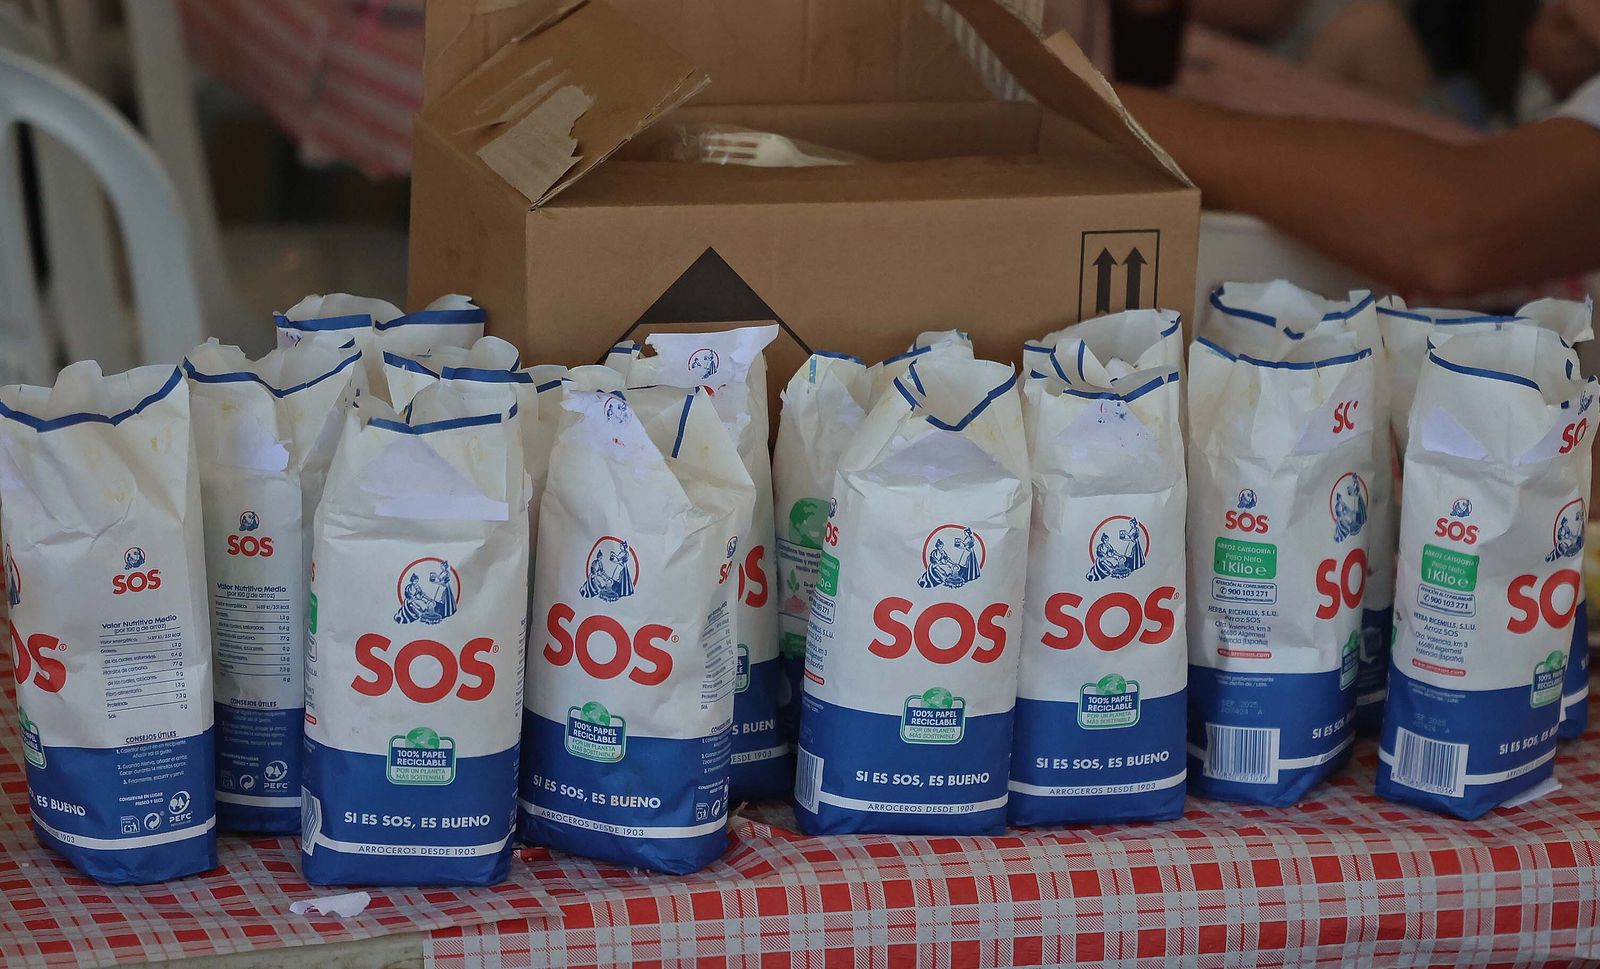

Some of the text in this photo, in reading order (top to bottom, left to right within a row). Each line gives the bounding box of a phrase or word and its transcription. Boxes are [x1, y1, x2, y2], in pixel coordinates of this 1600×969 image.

[1225, 510, 1269, 534] SOS
[1434, 517, 1478, 545] SOS
[227, 535, 274, 557] SOS
[1226, 553, 1242, 561] Peso
[1222, 561, 1254, 574] 1 Kilo
[113, 569, 161, 595] SOS
[1432, 570, 1456, 585] Kilo
[217, 582, 287, 594] Valor Nutritivo Medio
[1430, 596, 1443, 605] 900
[1443, 599, 1455, 607] 103
[1456, 601, 1468, 610] 271
[102, 614, 177, 630] Valor Nutritivo Medio
[1040, 586, 1176, 652] SOS
[868, 596, 1010, 665] SOS
[1424, 624, 1459, 638] Arroz SOS
[543, 603, 674, 687] SOS
[350, 633, 496, 704] SOS
[1087, 702, 1132, 712] RECICLABLE
[1088, 695, 1132, 704] 100% PAPEL
[912, 709, 957, 718] 100% PAPEL
[574, 721, 617, 736] 100% PAPEL
[911, 717, 957, 726] RECICLABLE
[126, 730, 177, 744] CONSEJOS ÚTILES
[573, 729, 616, 744] RECICLABLE
[1312, 724, 1334, 739] SI ES
[397, 749, 447, 759] 100% PAPEL
[754, 750, 772, 760] 1903
[1499, 743, 1508, 755] SI
[1510, 740, 1520, 753] ES
[396, 758, 447, 767] RECICLABLE
[1036, 750, 1170, 770] SI ES SOS, ES BUENO
[856, 770, 990, 787] SI ES SOS, ES BUENO
[533, 774, 661, 809] SI ES SOS, ES BUENO
[1049, 783, 1156, 795] ARROCEROS DESDE 1903
[37, 796, 86, 817] ES BUENO
[867, 803, 923, 812] ARROCEROS
[957, 804, 974, 812] 1903
[169, 812, 192, 823] PEFC
[344, 811, 490, 829] SI ES SOS, ES BUENO
[541, 809, 644, 836] ARROCEROS DESDE 1903
[60, 832, 76, 844] 1903
[358, 845, 476, 856] ARROCEROS DESDE 1903
